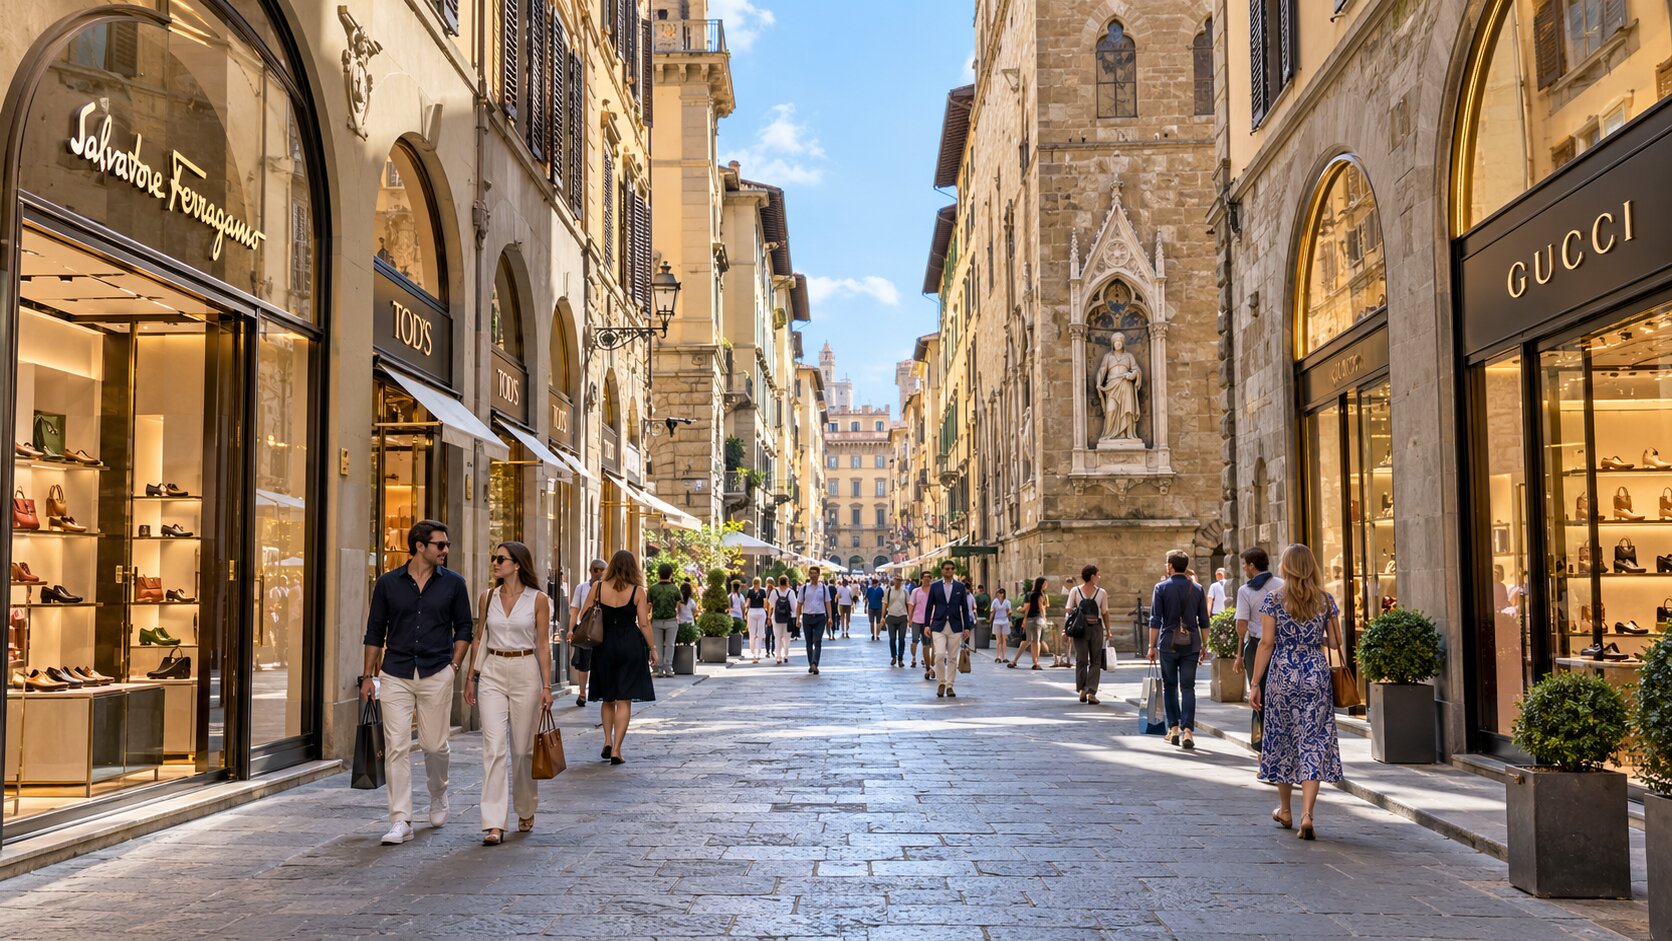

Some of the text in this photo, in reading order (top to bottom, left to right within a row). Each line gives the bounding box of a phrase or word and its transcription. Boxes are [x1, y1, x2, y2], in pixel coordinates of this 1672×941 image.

[70, 101, 267, 262] Salvatore Ferragamo
[1507, 200, 1633, 298] GUCCI
[392, 300, 432, 356] TOD'S
